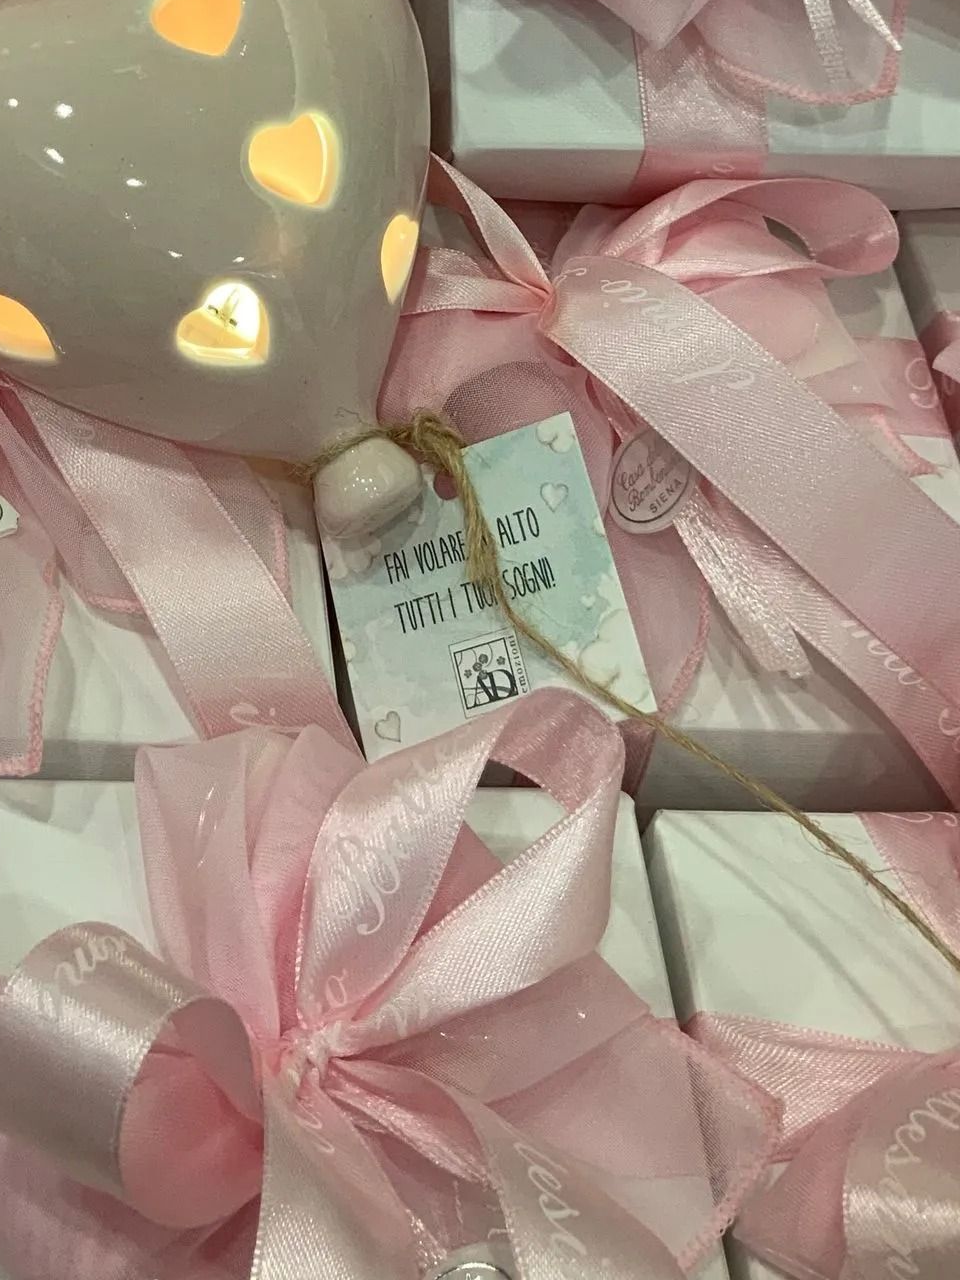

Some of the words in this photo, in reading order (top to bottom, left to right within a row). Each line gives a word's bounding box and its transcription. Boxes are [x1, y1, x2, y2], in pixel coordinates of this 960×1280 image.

[383, 549, 410, 585] FAI
[413, 530, 469, 575] VOLARE
[496, 506, 540, 549] ALTO
[393, 591, 445, 634] TUTTI
[447, 587, 457, 618] I
[501, 556, 556, 601] SOGNI!
[507, 634, 528, 695] emozioni
